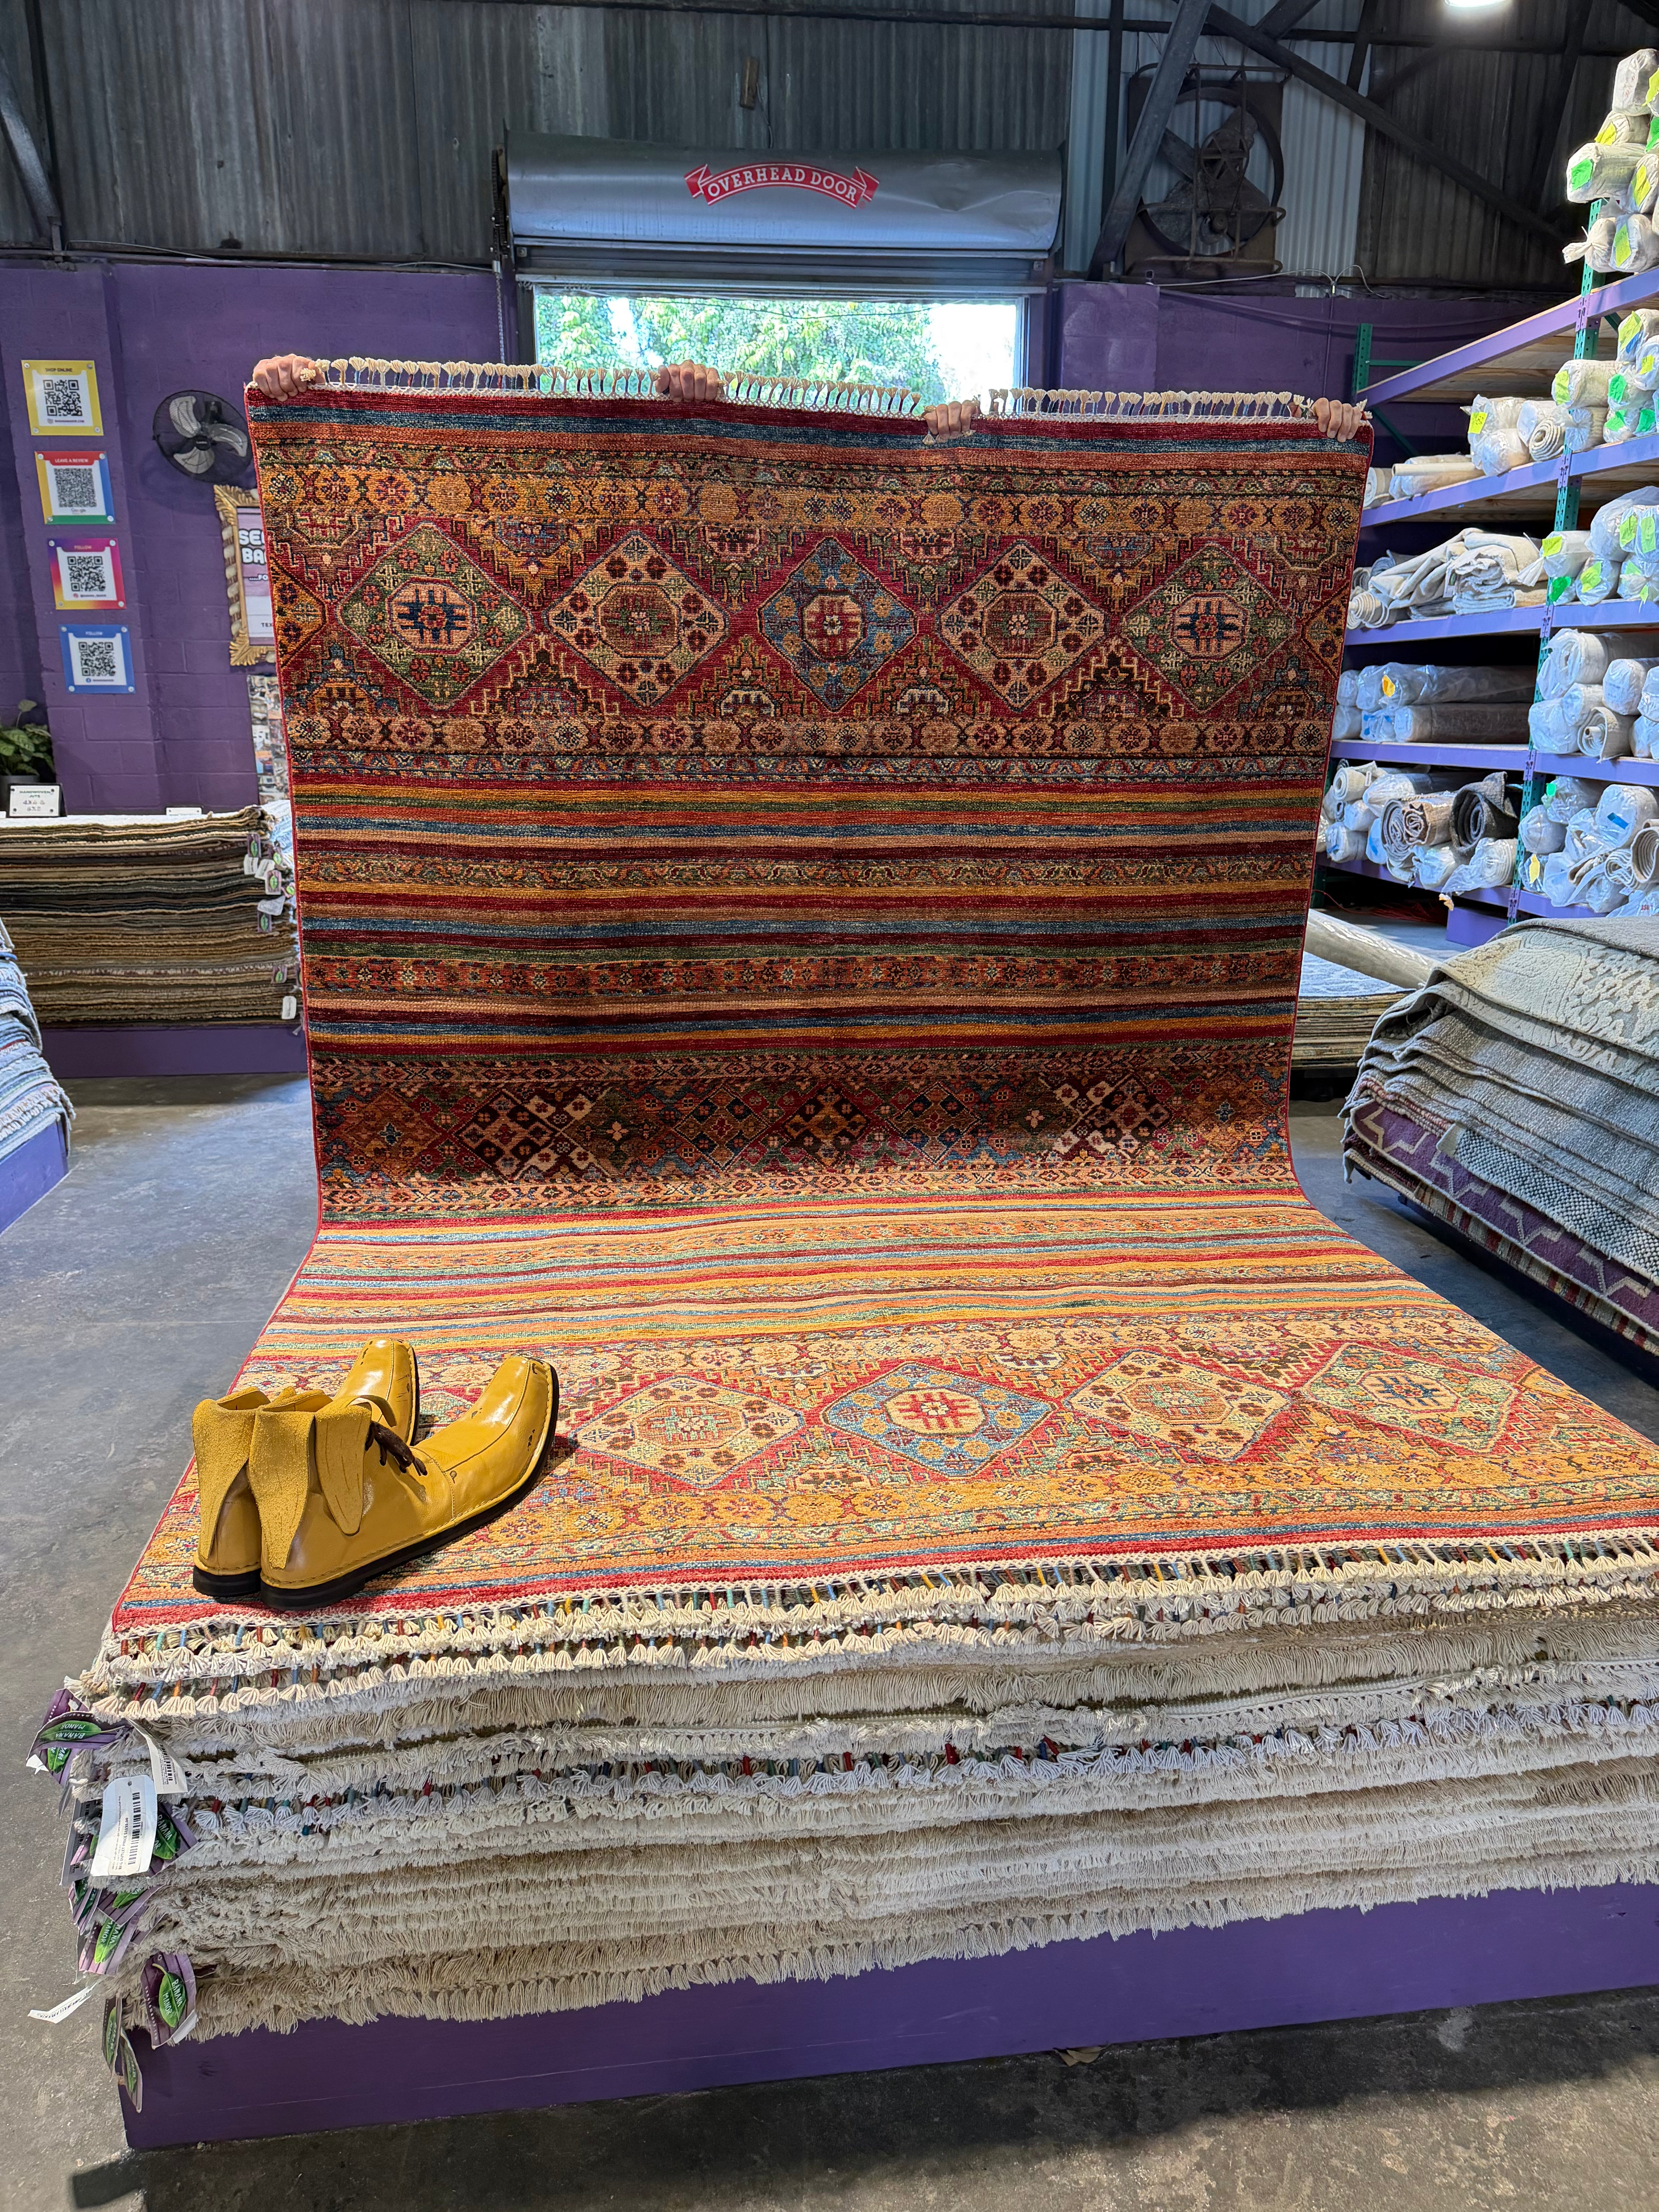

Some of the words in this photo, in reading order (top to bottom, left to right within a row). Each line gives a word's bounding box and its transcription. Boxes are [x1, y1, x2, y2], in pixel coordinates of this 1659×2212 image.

[708, 168, 805, 197] OVERHEAD
[811, 172, 855, 202] DOOR
[239, 529, 265, 546] SE
[241, 546, 267, 565] BA
[109, 1925, 120, 1944] NANA
[163, 1992, 172, 2015] MANOR
[172, 1978, 182, 2008] BANANA
